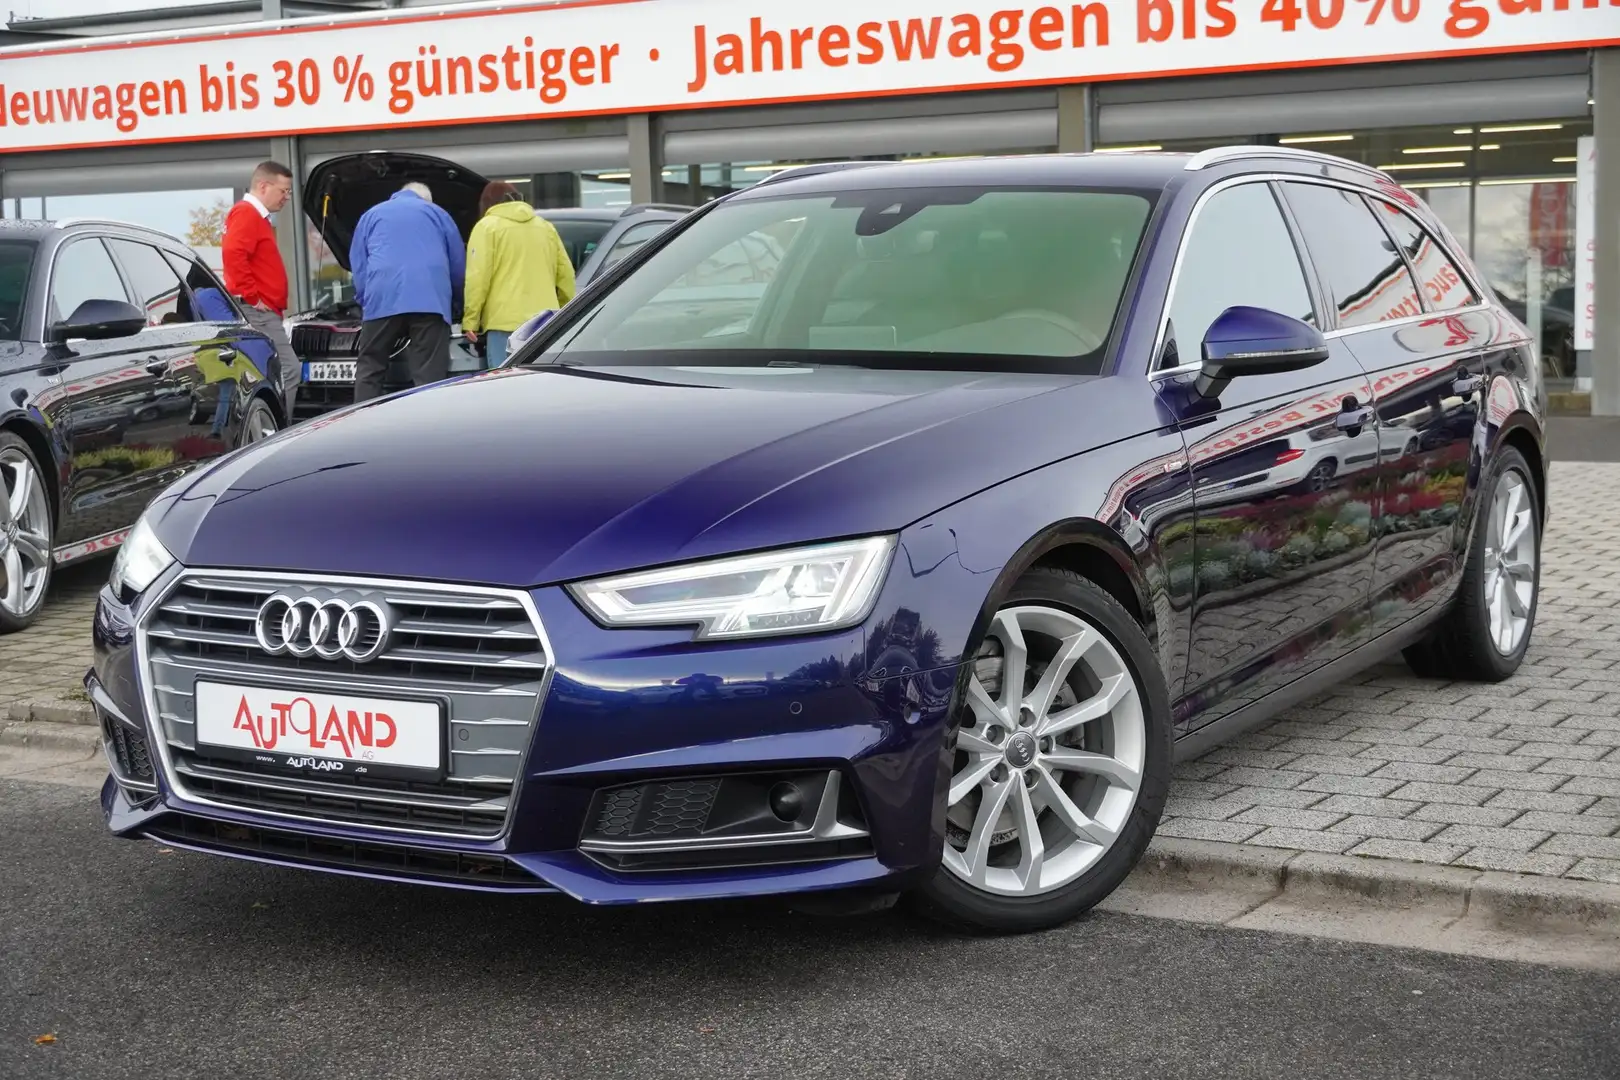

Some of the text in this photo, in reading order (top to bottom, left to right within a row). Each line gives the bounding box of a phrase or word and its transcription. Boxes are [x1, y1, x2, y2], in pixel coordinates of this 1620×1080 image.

[200, 61, 260, 112] bis
[272, 59, 321, 108] 30
[333, 55, 375, 102] %
[388, 36, 621, 114] günstiger
[688, 1, 1110, 93] Jahreswagen
[1136, 0, 1238, 43] bis
[233, 694, 397, 758] AUTOLAND
[286, 756, 344, 771] AUTOLAND
[361, 750, 374, 760] AG
